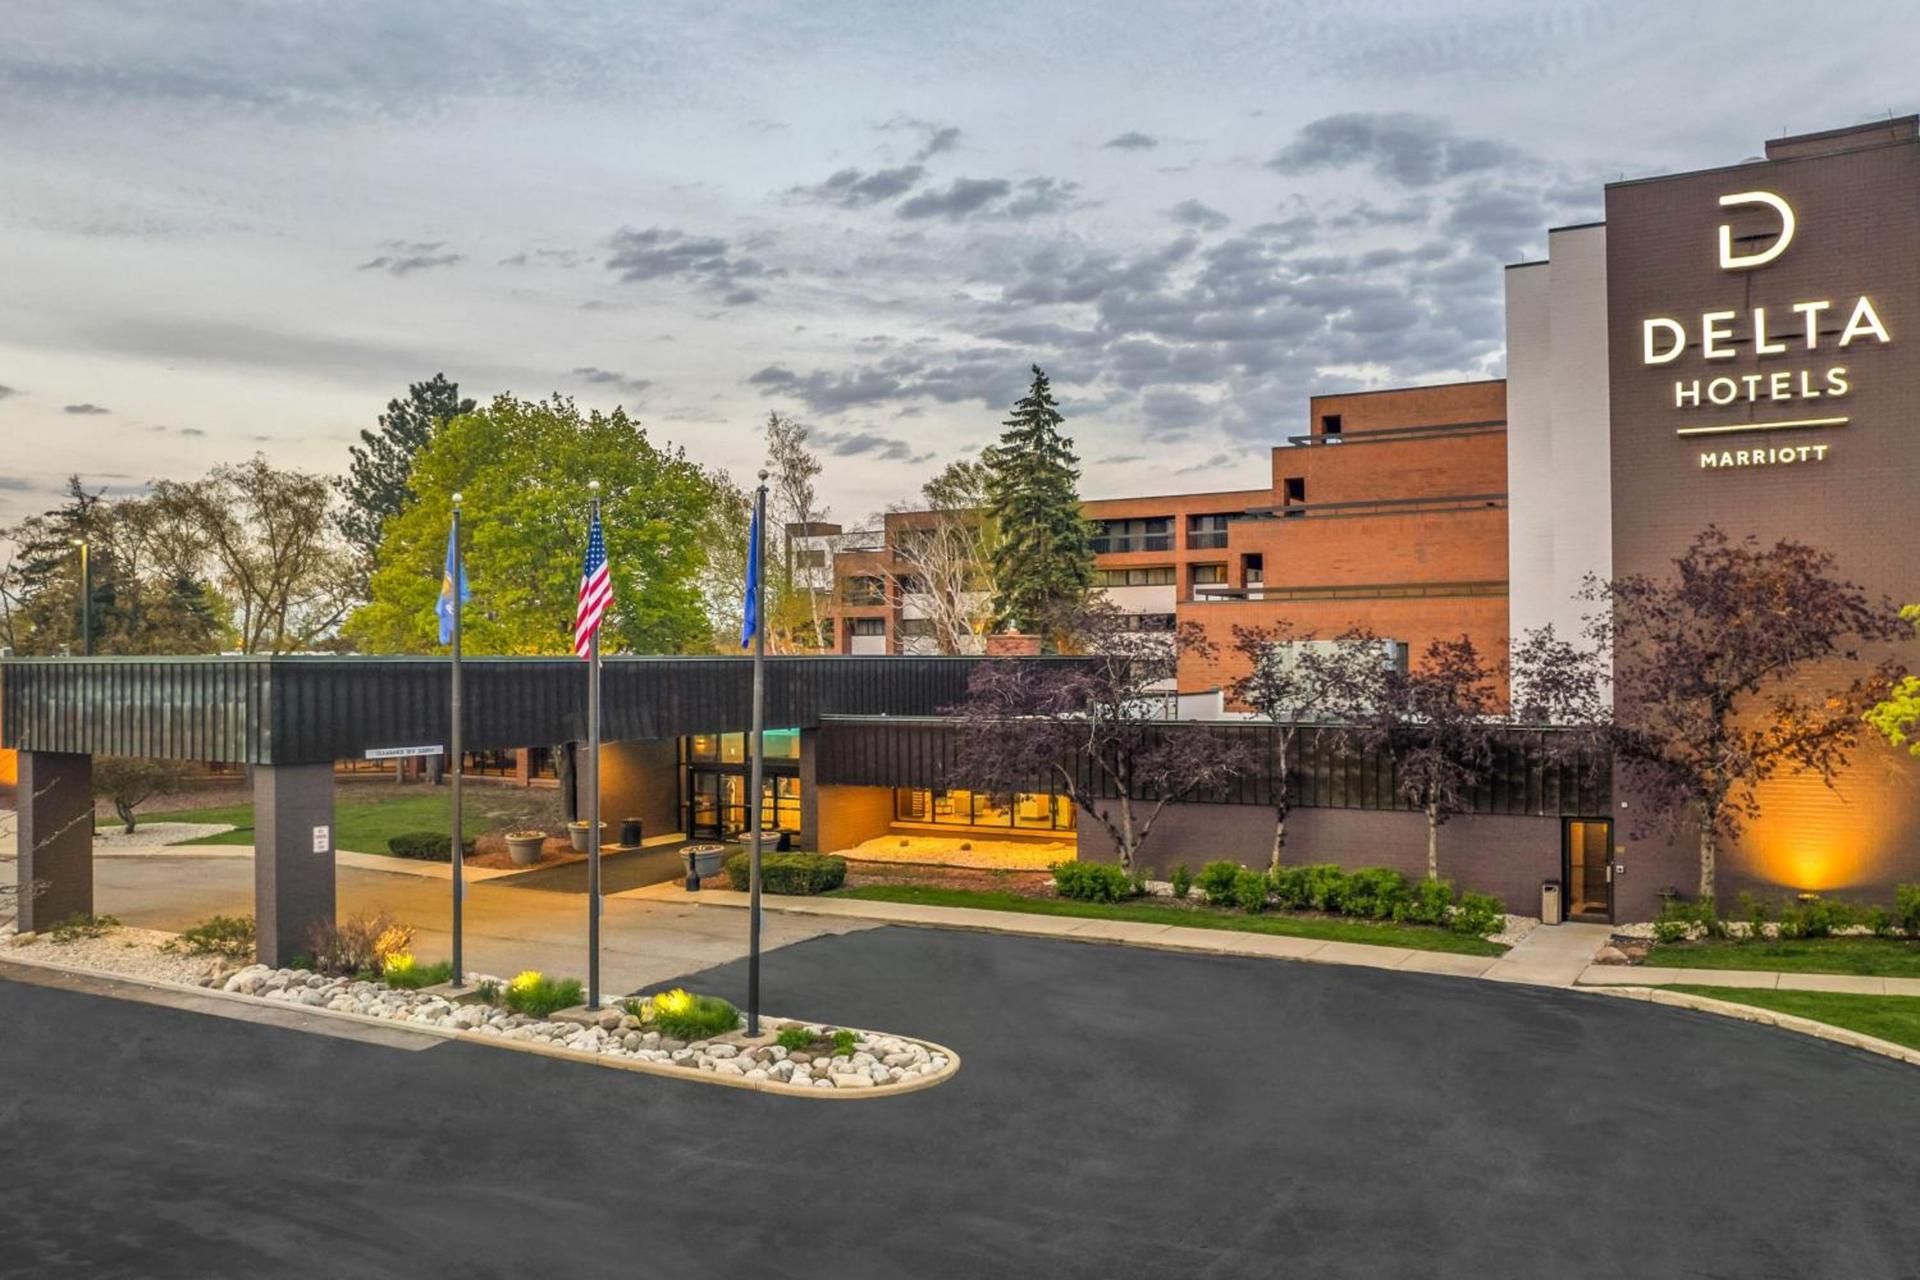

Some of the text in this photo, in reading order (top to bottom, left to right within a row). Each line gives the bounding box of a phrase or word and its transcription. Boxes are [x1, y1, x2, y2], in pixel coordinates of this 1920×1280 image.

[1643, 296, 1891, 364] DELTA
[1675, 367, 1849, 407] HOTELS
[1700, 445, 1829, 469] MARRIOTT
